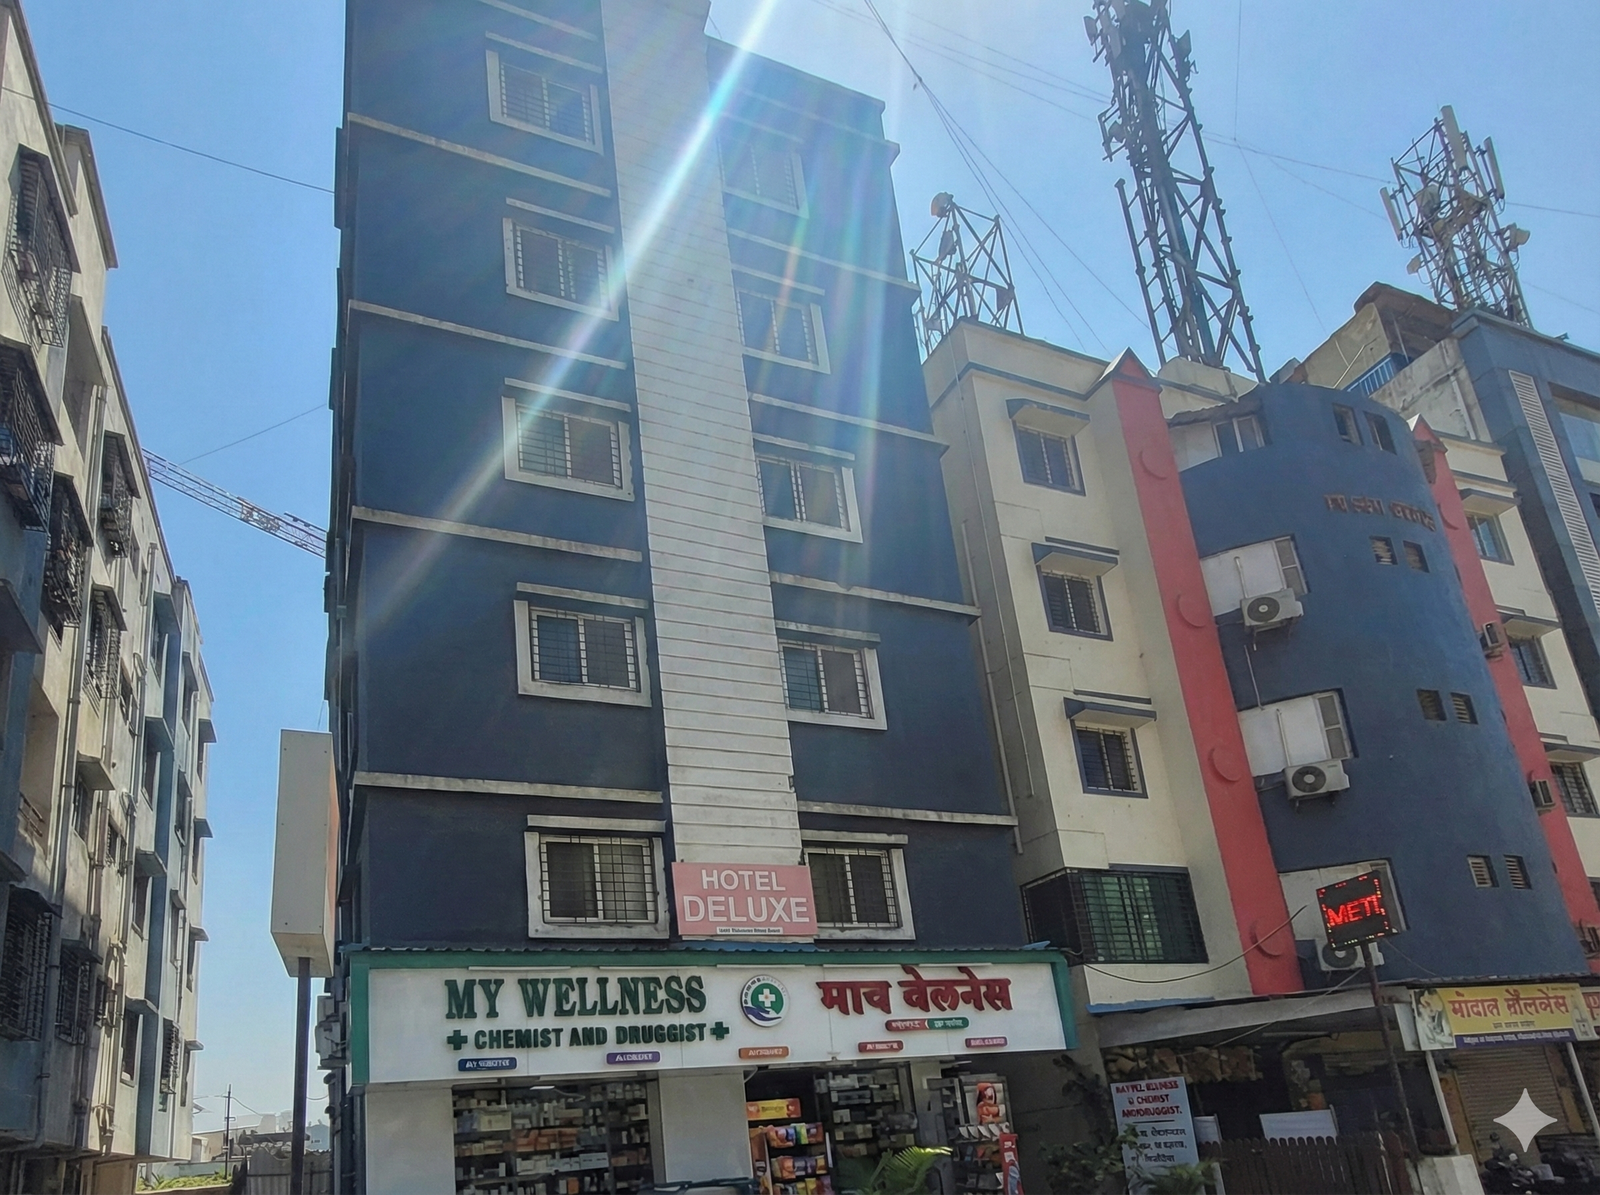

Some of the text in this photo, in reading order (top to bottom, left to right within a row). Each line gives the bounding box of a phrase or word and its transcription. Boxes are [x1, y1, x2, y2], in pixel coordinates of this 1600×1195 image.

[701, 869, 786, 891] HOTEL
[683, 895, 810, 923] DELUXE
[445, 978, 504, 1019] MY
[517, 975, 707, 1018] WELLNESS
[474, 1023, 707, 1050] CHEMIST AND DRUGGIST
